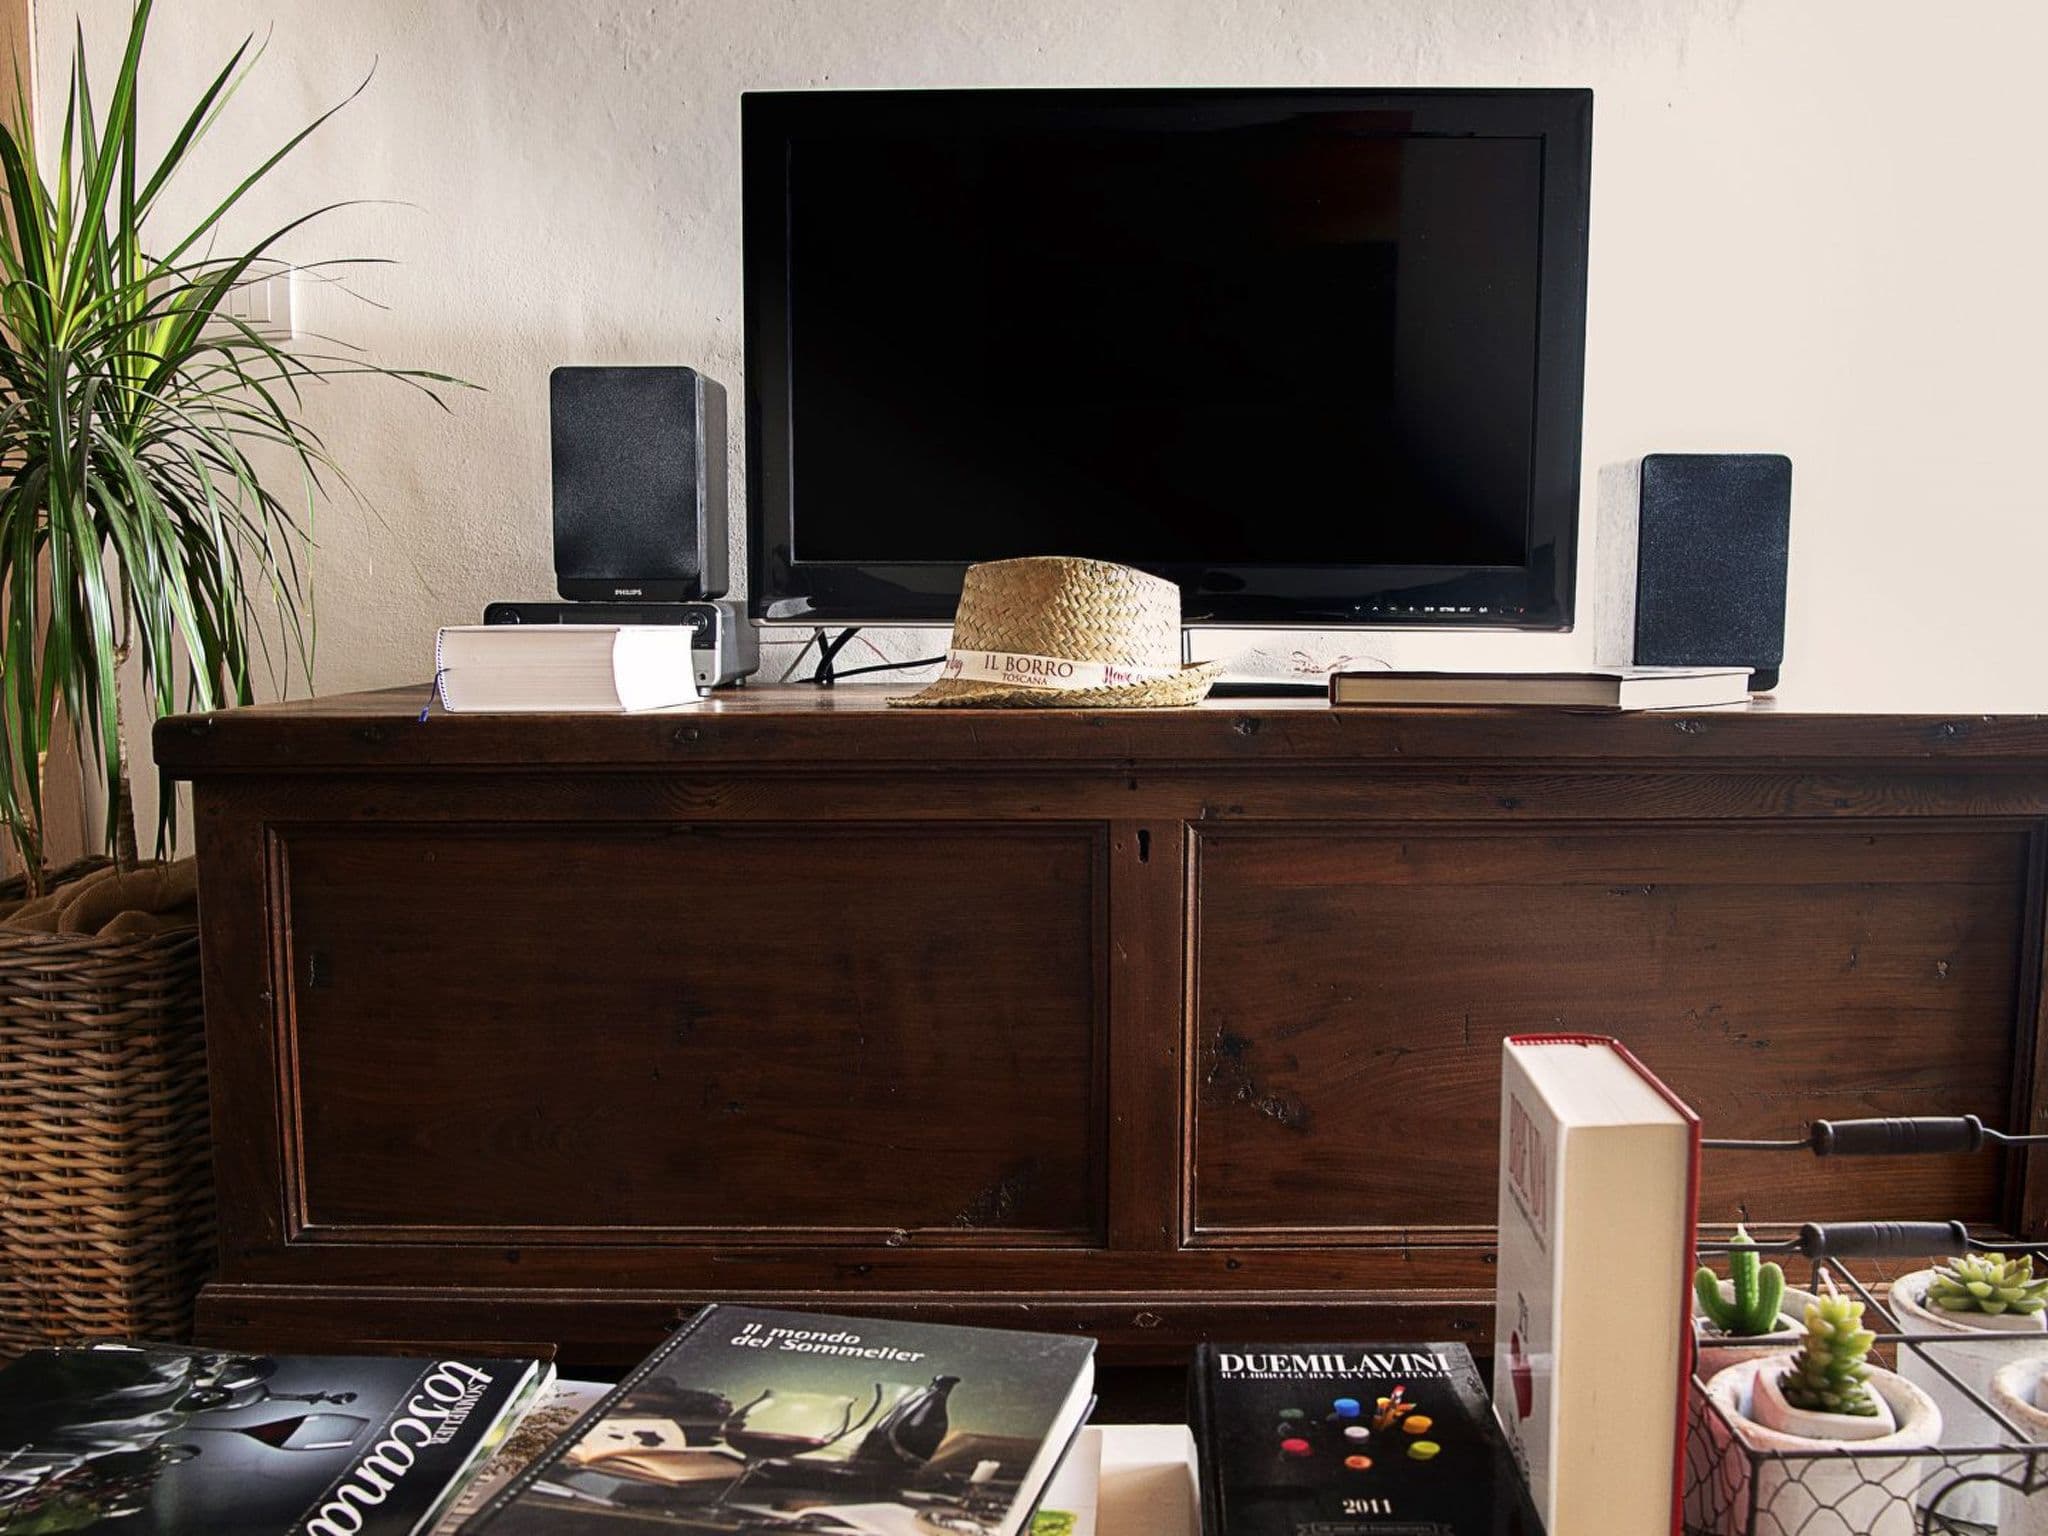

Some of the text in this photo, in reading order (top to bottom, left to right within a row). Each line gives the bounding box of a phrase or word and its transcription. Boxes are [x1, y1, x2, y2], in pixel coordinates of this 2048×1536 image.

[984, 654, 1073, 677] IL BORRO
[1002, 673, 1048, 685] TOSCANA
[769, 1327, 861, 1345] mondo
[730, 1335, 925, 1363] del Sommelier
[1219, 1354, 1451, 1372] DUEMILAVINI
[1342, 1498, 1392, 1515] 2011
